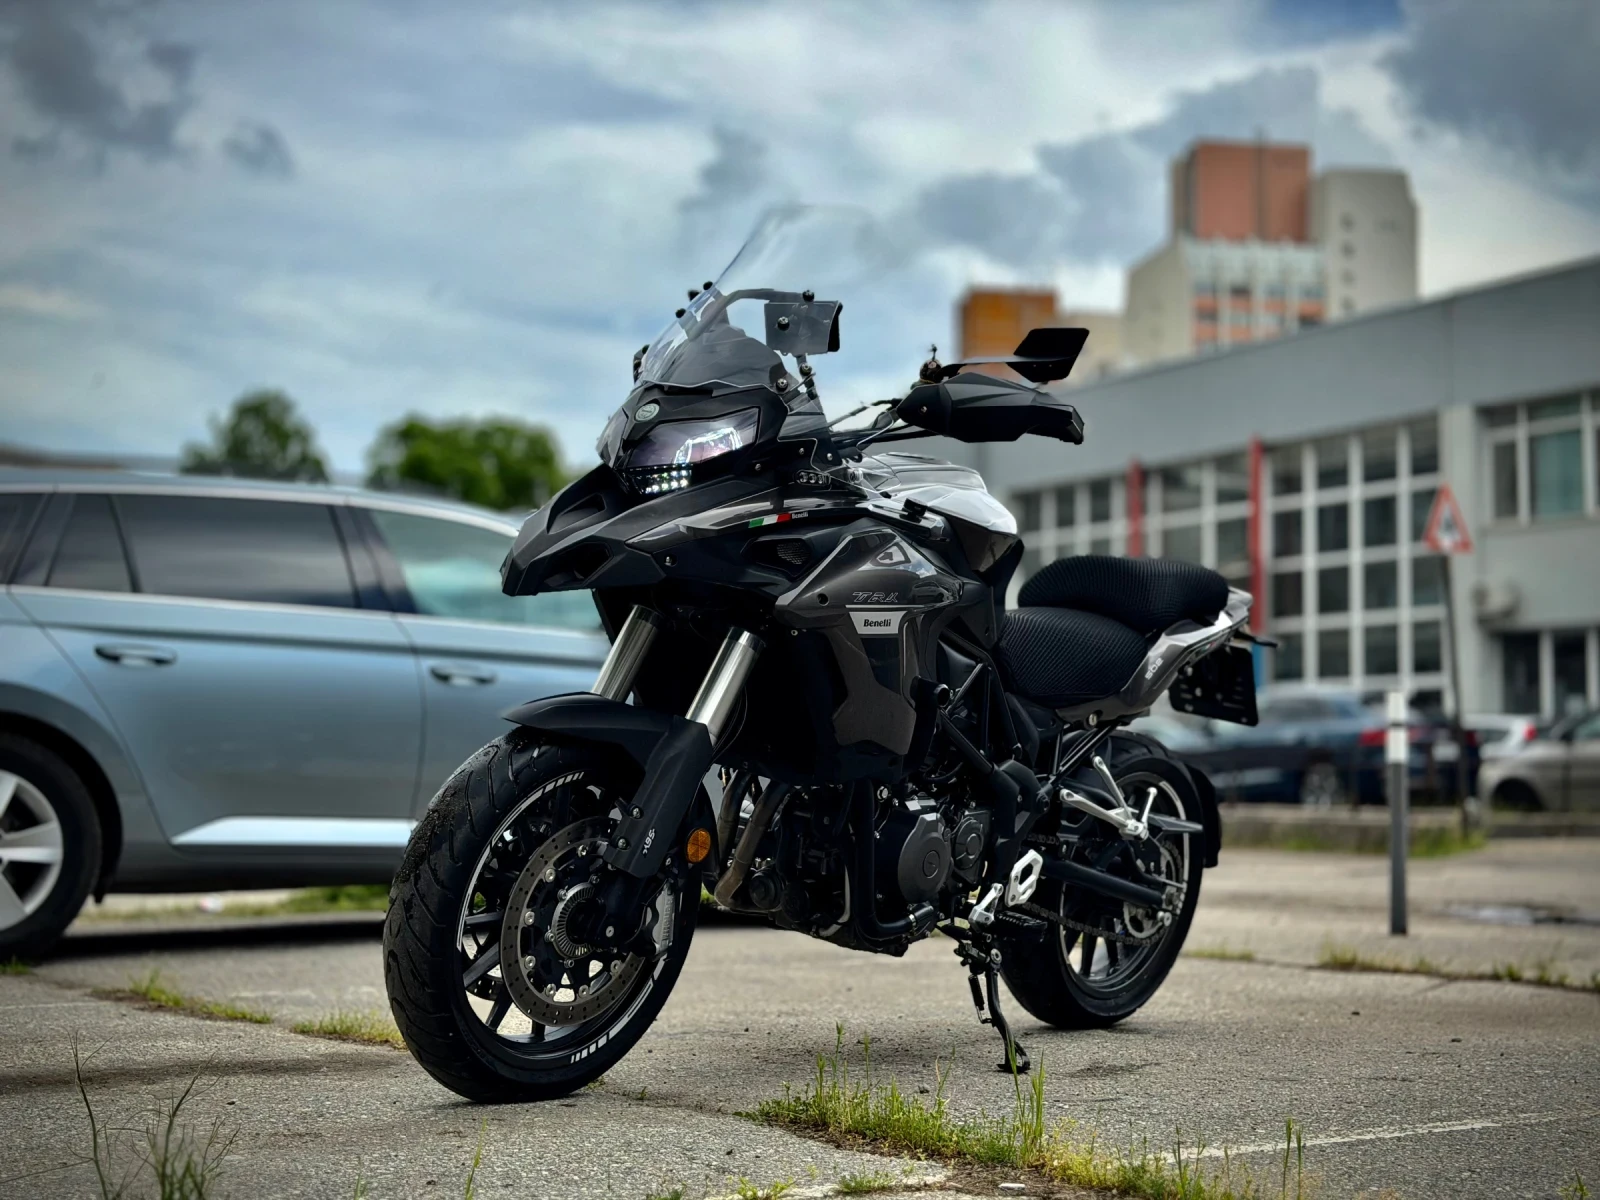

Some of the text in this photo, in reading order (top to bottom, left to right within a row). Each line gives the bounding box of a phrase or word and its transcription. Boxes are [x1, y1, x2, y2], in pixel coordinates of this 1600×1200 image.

[791, 511, 809, 519] Benelli
[852, 591, 899, 603] TRK
[863, 618, 892, 627] Benelli
[1144, 657, 1164, 680] 502
